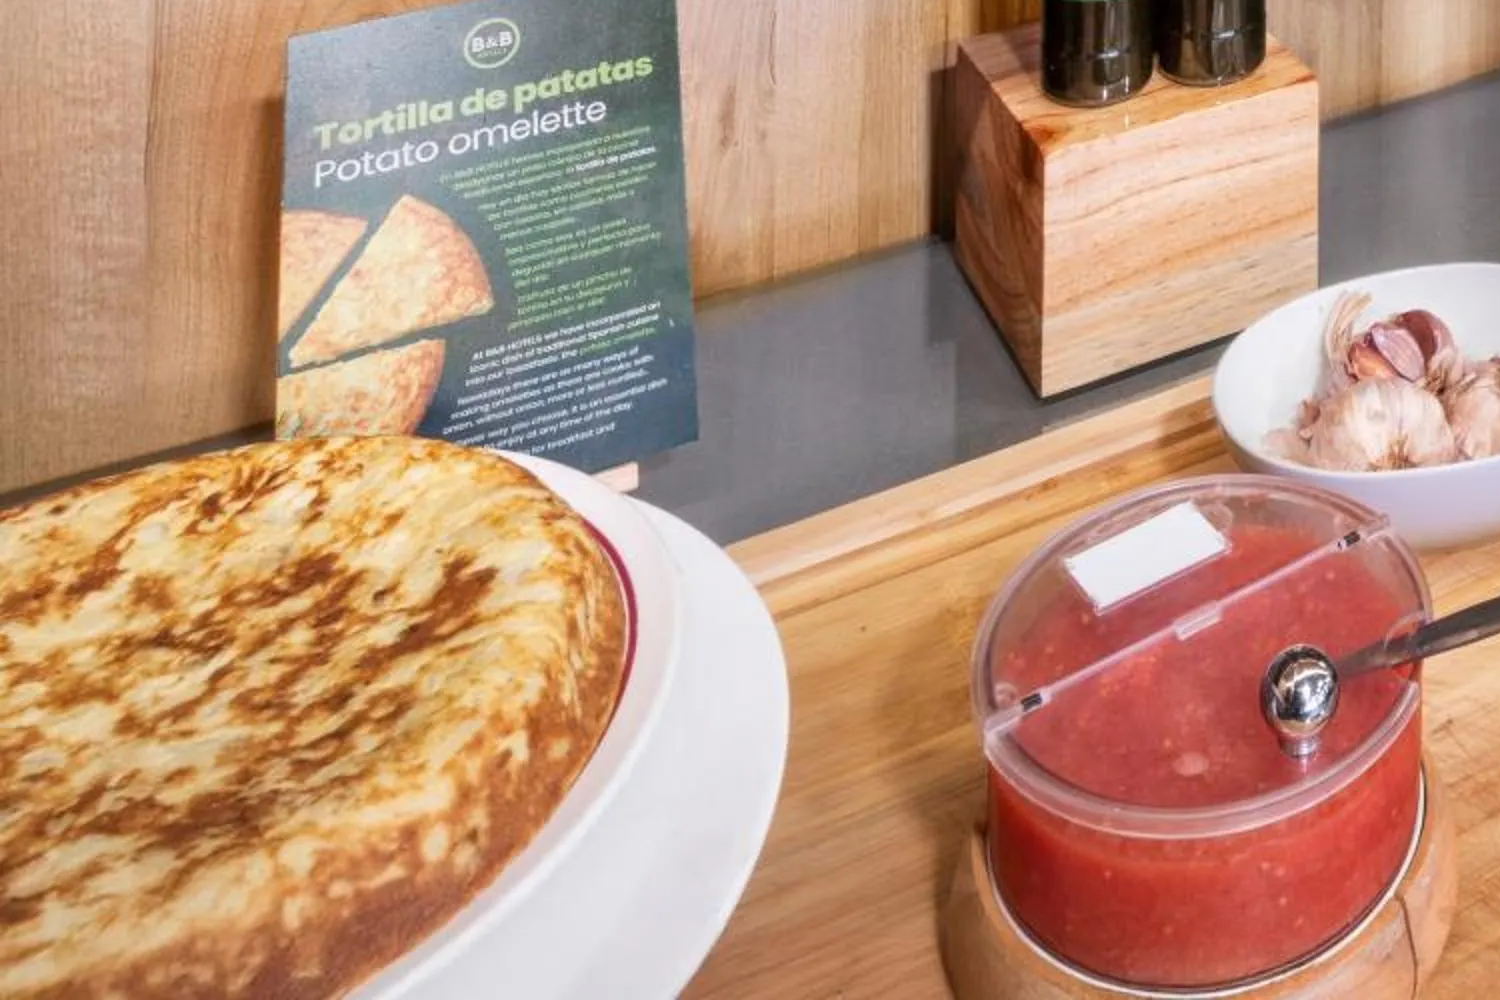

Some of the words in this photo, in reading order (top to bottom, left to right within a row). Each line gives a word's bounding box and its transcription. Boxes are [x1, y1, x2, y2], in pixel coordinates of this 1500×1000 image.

[471, 31, 513, 53] B&B
[313, 100, 453, 150] Tortilla
[459, 87, 508, 118] de
[513, 56, 653, 114] patatas
[314, 138, 439, 189] Potato
[447, 99, 608, 156] omelette
